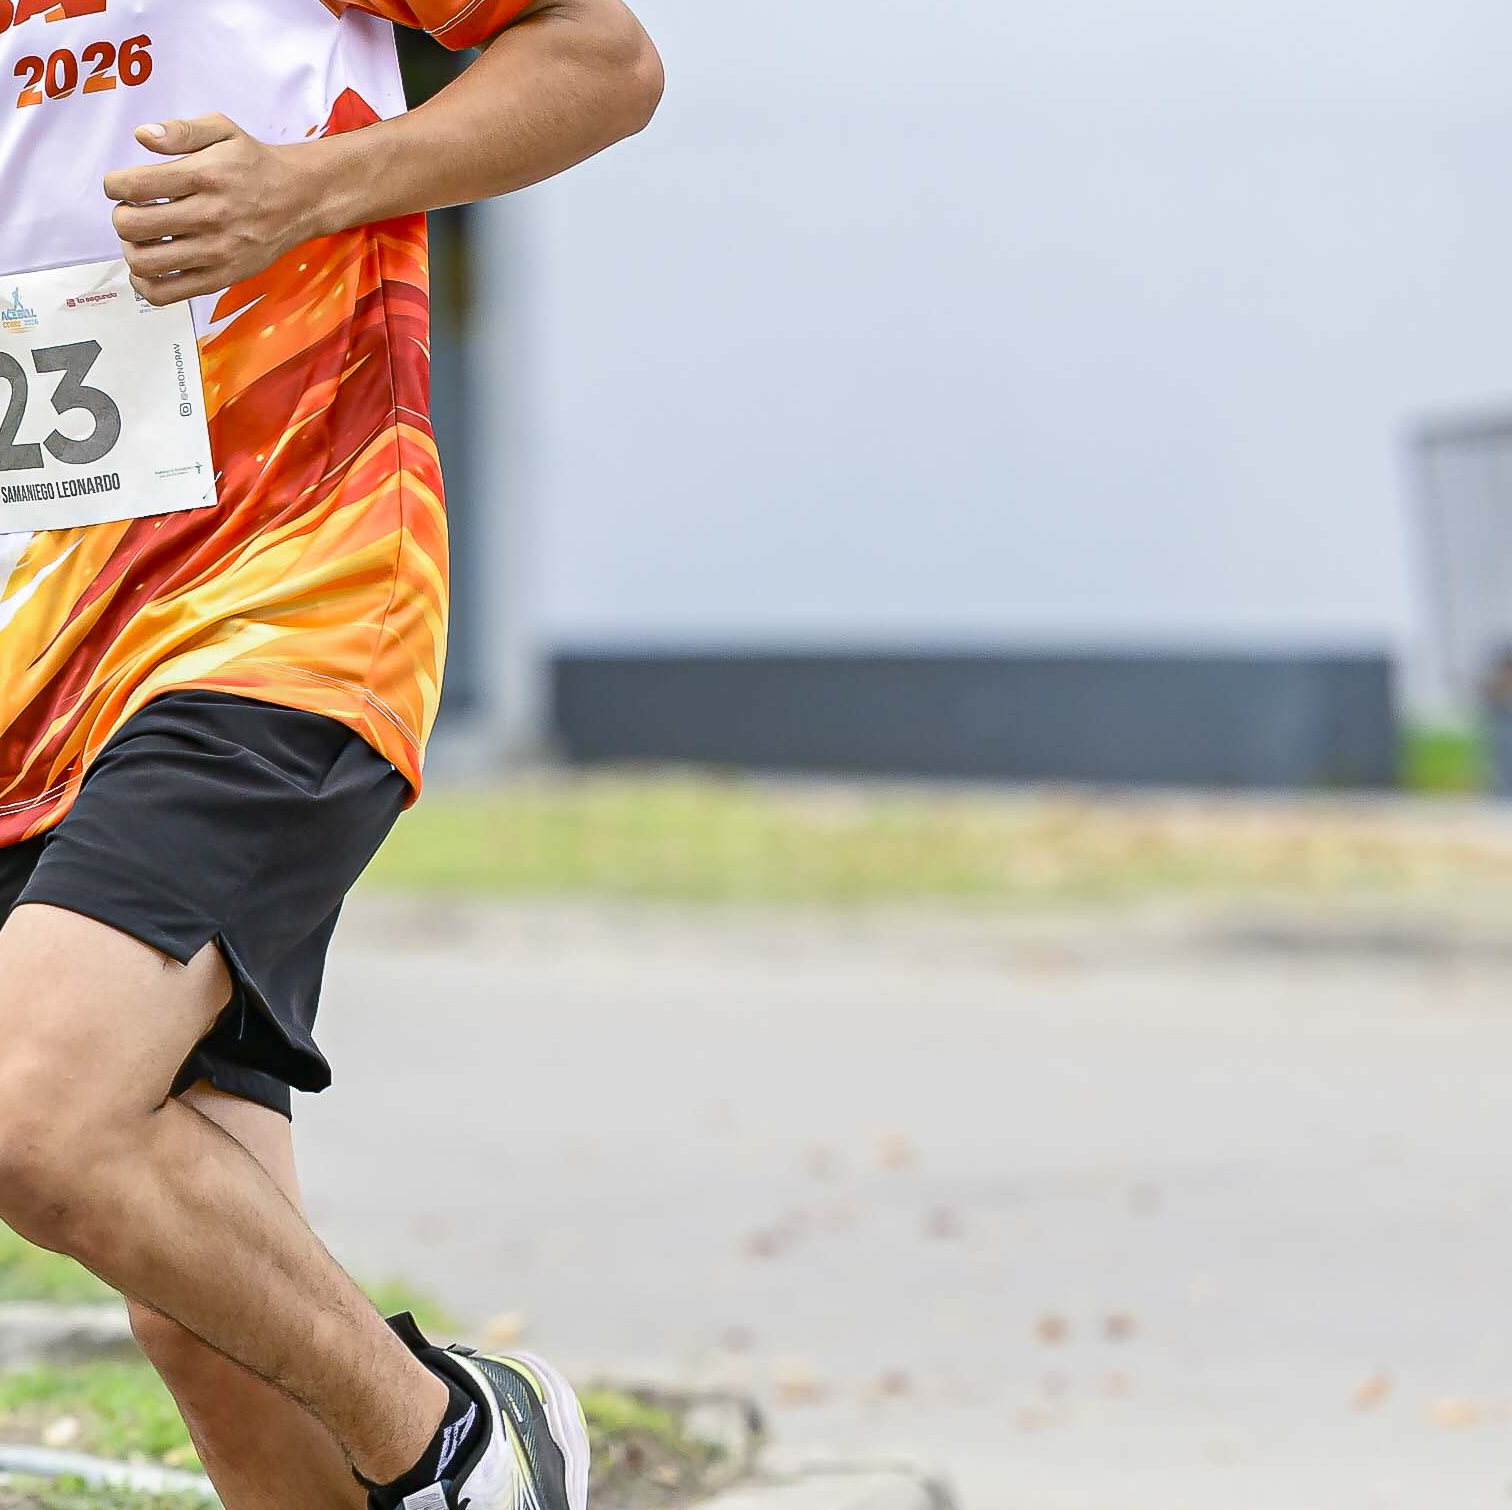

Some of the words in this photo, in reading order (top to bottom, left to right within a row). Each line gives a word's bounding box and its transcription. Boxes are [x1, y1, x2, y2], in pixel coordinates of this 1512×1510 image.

[13, 34, 153, 108] 2026
[0, 482, 55, 504] SAMANIEGO
[55, 472, 121, 499] LEONARDO
